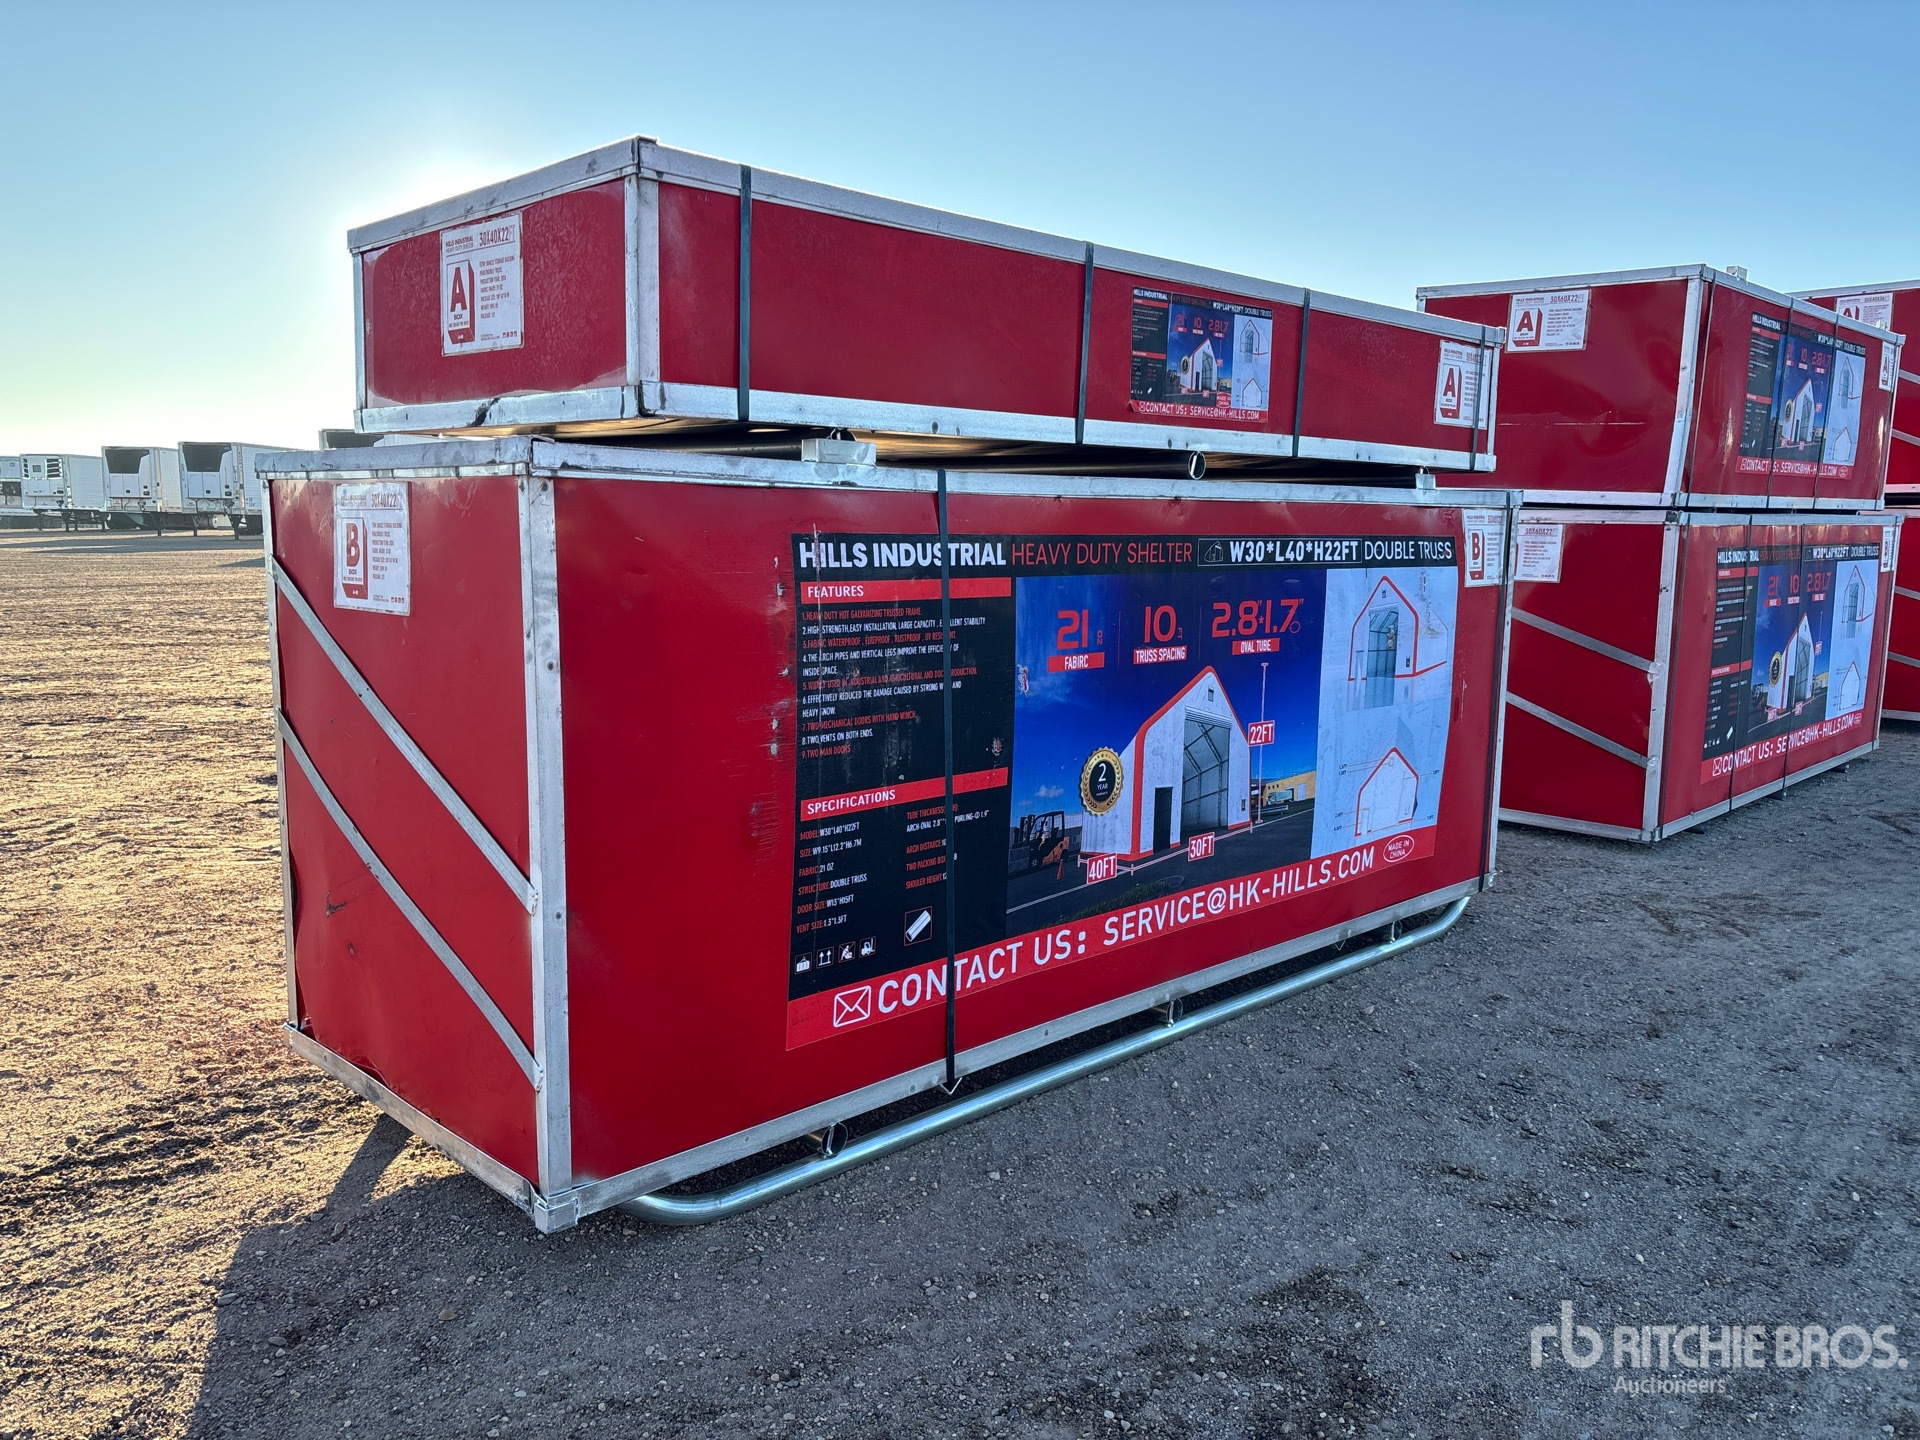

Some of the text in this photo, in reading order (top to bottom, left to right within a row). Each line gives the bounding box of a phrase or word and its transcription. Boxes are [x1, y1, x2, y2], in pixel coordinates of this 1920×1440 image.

[450, 266, 467, 312] A
[1144, 291, 1168, 300] INDUSTRIAL
[1516, 310, 1533, 332] A
[1443, 368, 1456, 397] A
[1145, 402, 1175, 414] CONTACT
[1190, 405, 1259, 420] SERVICE@HK-HILLS.COM
[346, 523, 360, 567] B
[800, 542, 868, 568] HILLS
[873, 542, 1006, 567] INDUSTRIAL
[1012, 543, 1072, 565] HEAVY
[1076, 542, 1123, 564] DUTY
[1127, 542, 1192, 564] SHELTER
[1365, 541, 1415, 560] DOUBLE
[1418, 540, 1452, 560] TRUSS
[1472, 533, 1480, 560] B
[1718, 551, 1732, 563] HILLS
[808, 585, 864, 598] FEATURES
[898, 620, 912, 629] LARGE
[914, 620, 935, 628] CAPACITY
[964, 617, 986, 626] STABILITY
[1056, 609, 1088, 650] 21
[1144, 605, 1176, 643] 10
[834, 652, 849, 660] PIPES
[850, 651, 860, 659] AND
[861, 649, 883, 658] VERTICAL
[1136, 647, 1186, 663] TRUSS SPACING
[1240, 639, 1271, 653] OVAL TUBE
[1064, 655, 1088, 670] FABIRC
[803, 668, 819, 676] INSIDE
[840, 691, 862, 700] REDUCED
[863, 690, 872, 698] THE
[873, 688, 892, 697] DAMAGE
[894, 685, 912, 695] CAUSED
[912, 685, 919, 693] BY
[920, 683, 938, 692] STRONG
[952, 681, 962, 689] AND
[802, 709, 818, 718] HEAVY
[837, 732, 844, 740] ON
[846, 730, 858, 739] BOTH
[1250, 723, 1273, 744] 22FT
[1722, 746, 1757, 773] CONTACT
[1098, 763, 1107, 782] 2
[807, 789, 896, 814] SPECIFICATIONS
[1190, 836, 1214, 857] 30FT
[1387, 839, 1410, 851] MADE IN
[1390, 850, 1405, 859] CHINA
[1089, 856, 1116, 882] 40FT
[851, 874, 868, 884] TRUSS
[797, 903, 812, 914] DOOR
[877, 846, 1374, 1014] CONTACT US: SERVICE@HK-HILLS.COM
